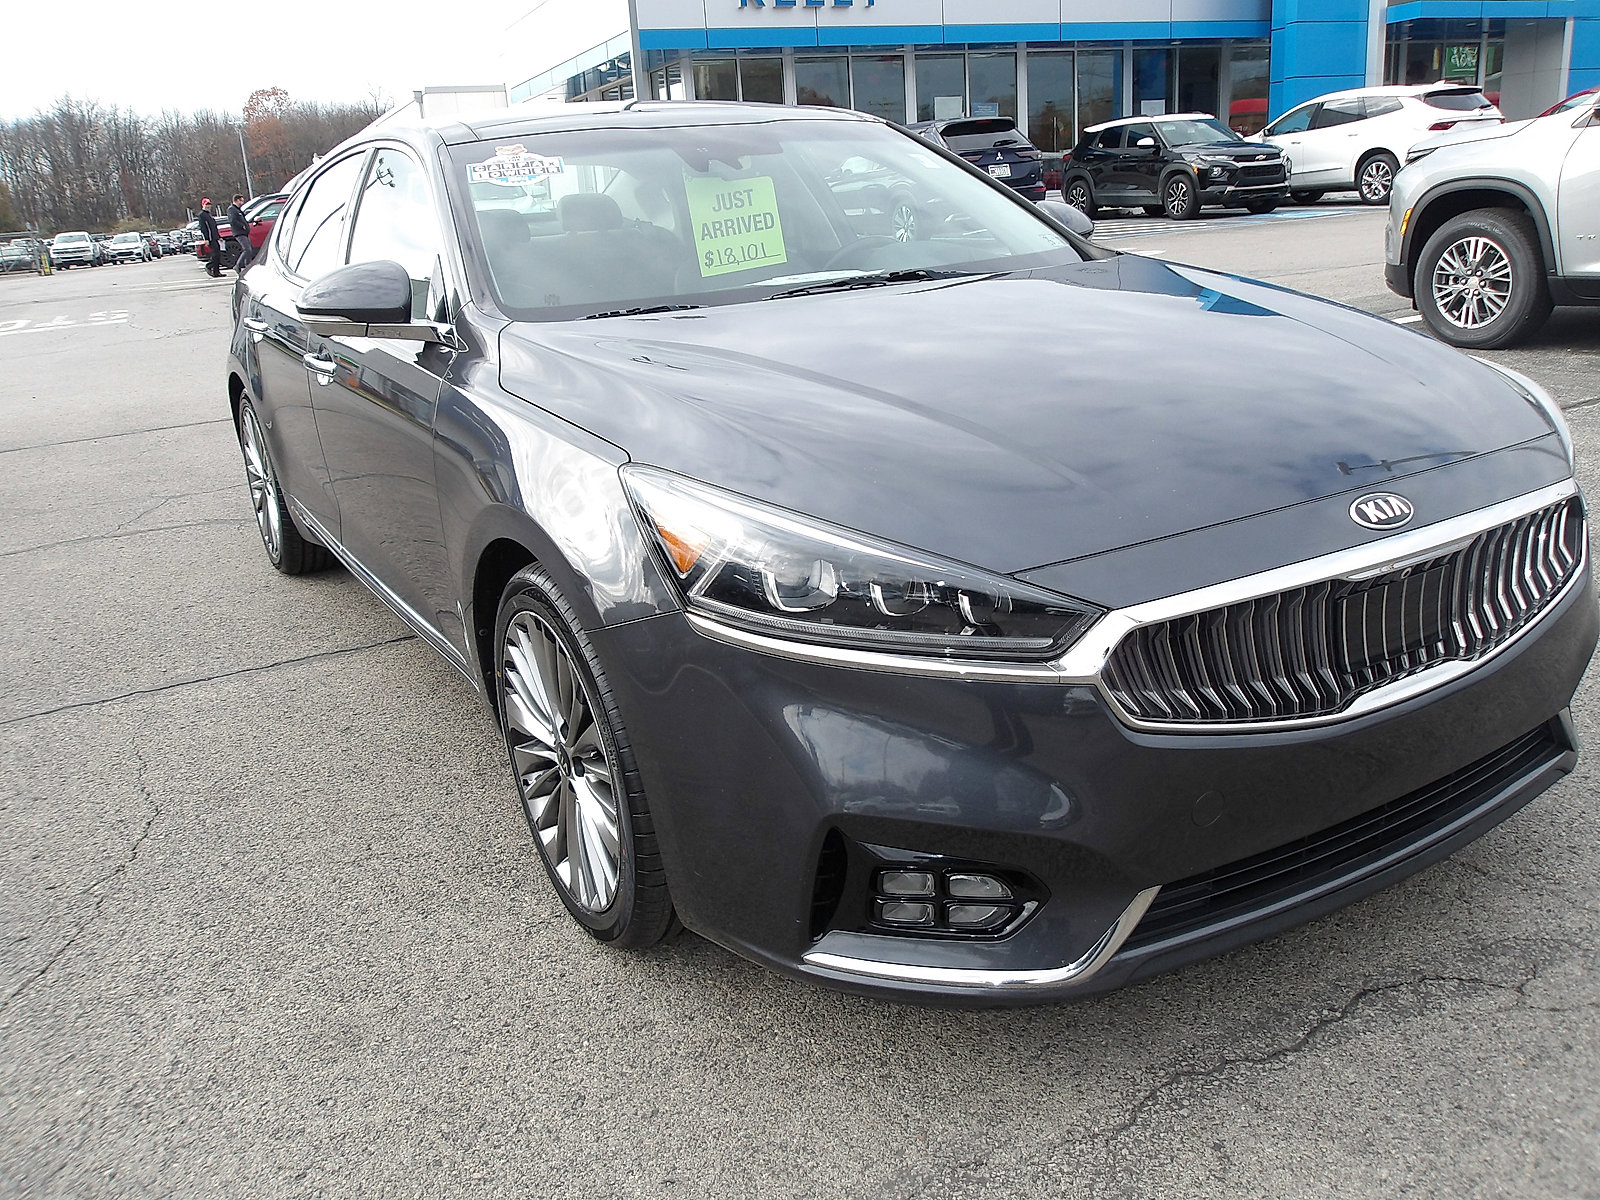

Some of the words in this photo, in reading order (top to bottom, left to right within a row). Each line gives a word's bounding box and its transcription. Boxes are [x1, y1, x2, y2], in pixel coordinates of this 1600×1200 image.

[712, 188, 753, 212] JUST
[701, 212, 775, 241] ARRIVED
[704, 242, 768, 268] $18,101
[1358, 496, 1410, 523] KIA
